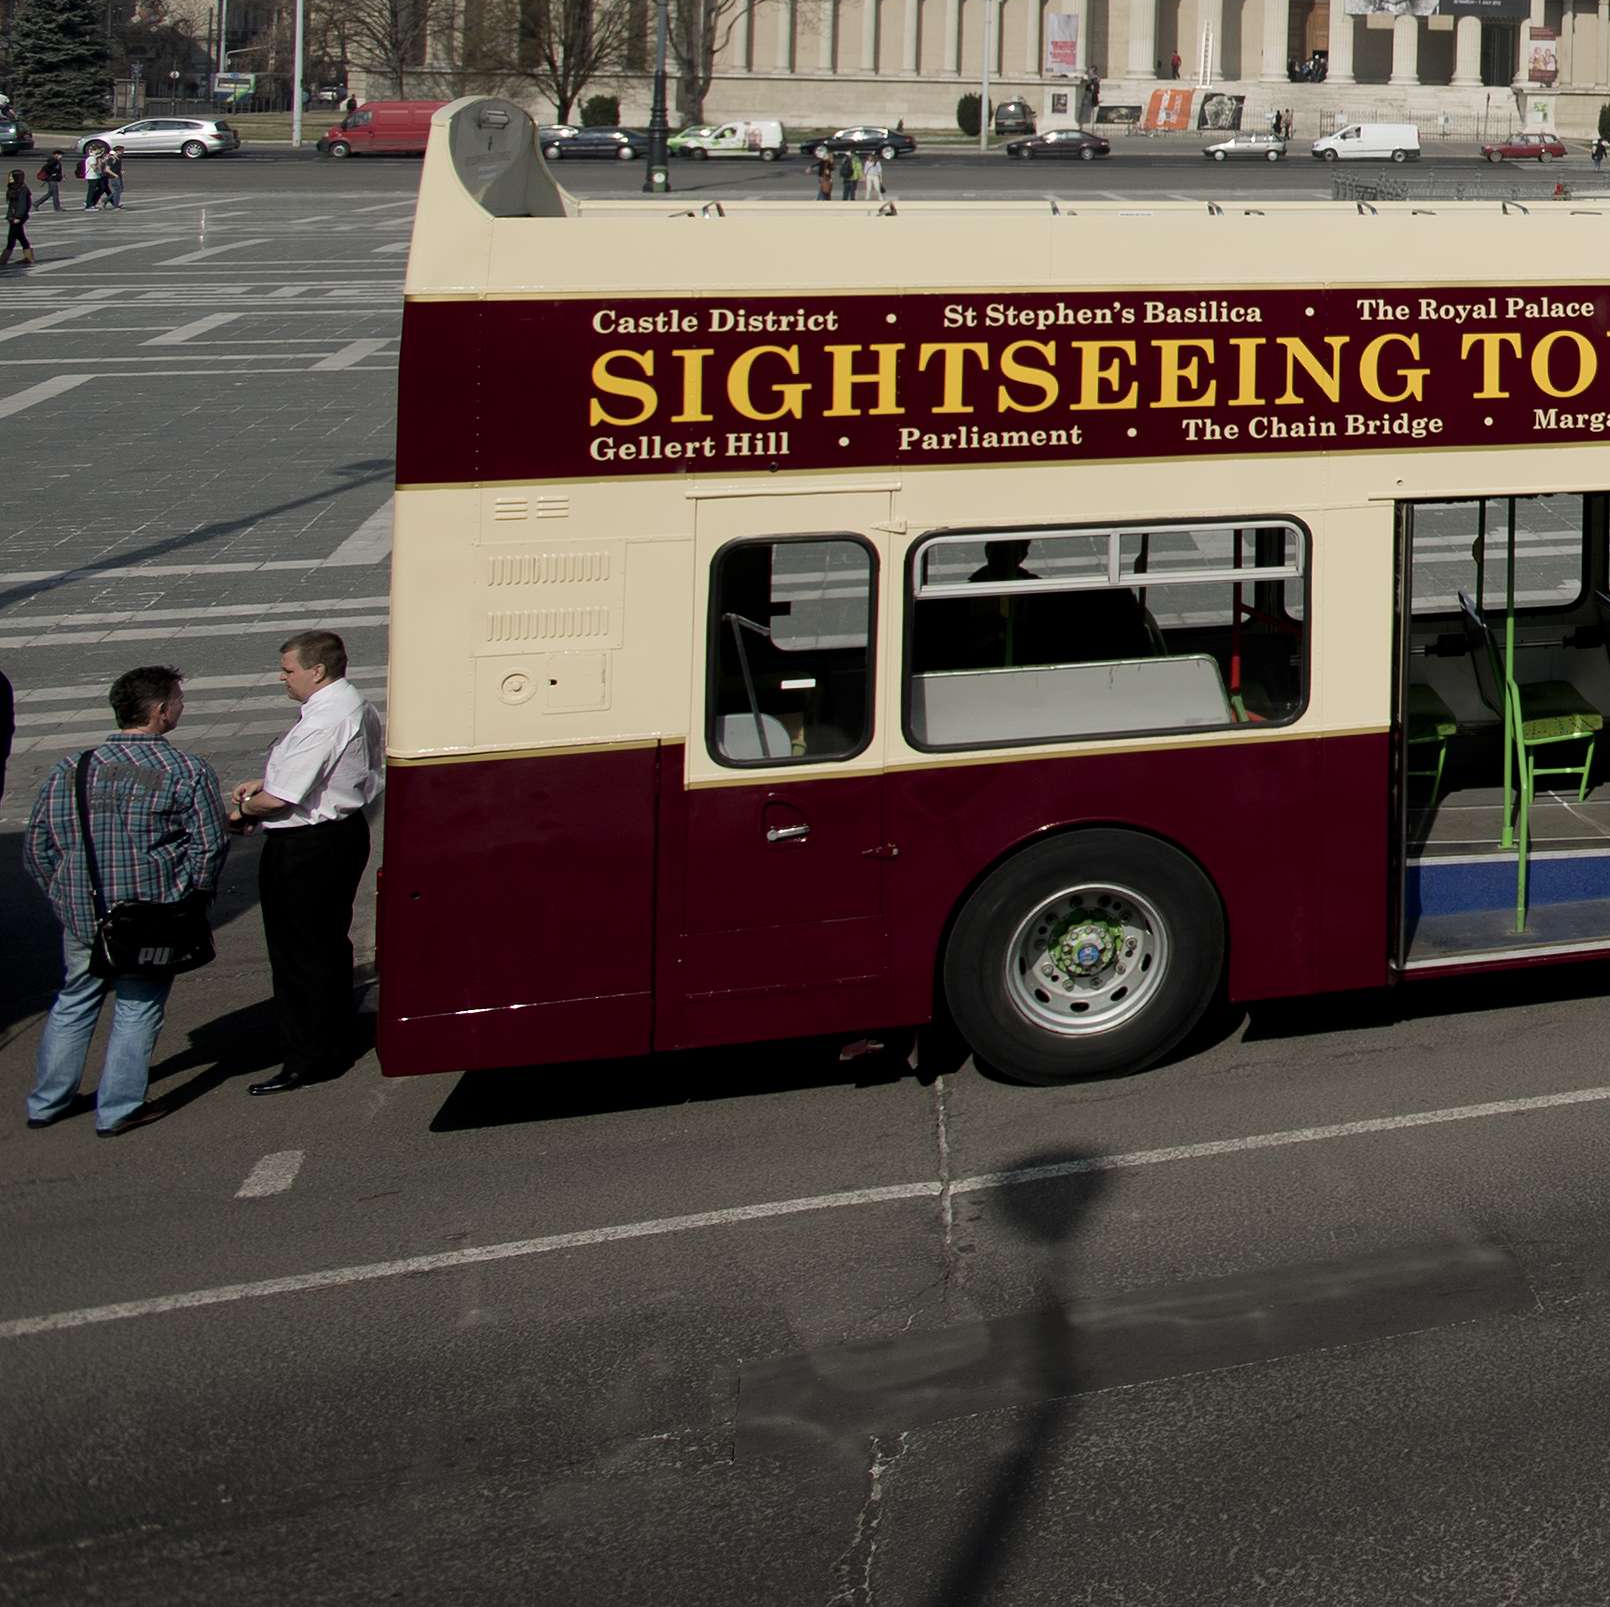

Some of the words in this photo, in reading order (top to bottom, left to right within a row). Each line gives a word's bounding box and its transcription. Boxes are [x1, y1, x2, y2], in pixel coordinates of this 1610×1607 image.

[593, 310, 697, 334] Castle
[709, 309, 838, 332] District
[944, 305, 977, 328] St
[986, 302, 1135, 330] Stephen's
[1144, 301, 1262, 324] Basilica
[1357, 300, 1409, 321] The
[1419, 298, 1497, 326] Royal
[1506, 297, 1594, 319] Palace
[590, 332, 1431, 427] SIGHTSEEING
[591, 432, 715, 462] Gellert
[726, 432, 789, 457] Hill
[899, 425, 1082, 451] Parliament
[1182, 419, 1238, 441] The
[1249, 415, 1336, 440] Chain
[1345, 413, 1442, 439] Bridge
